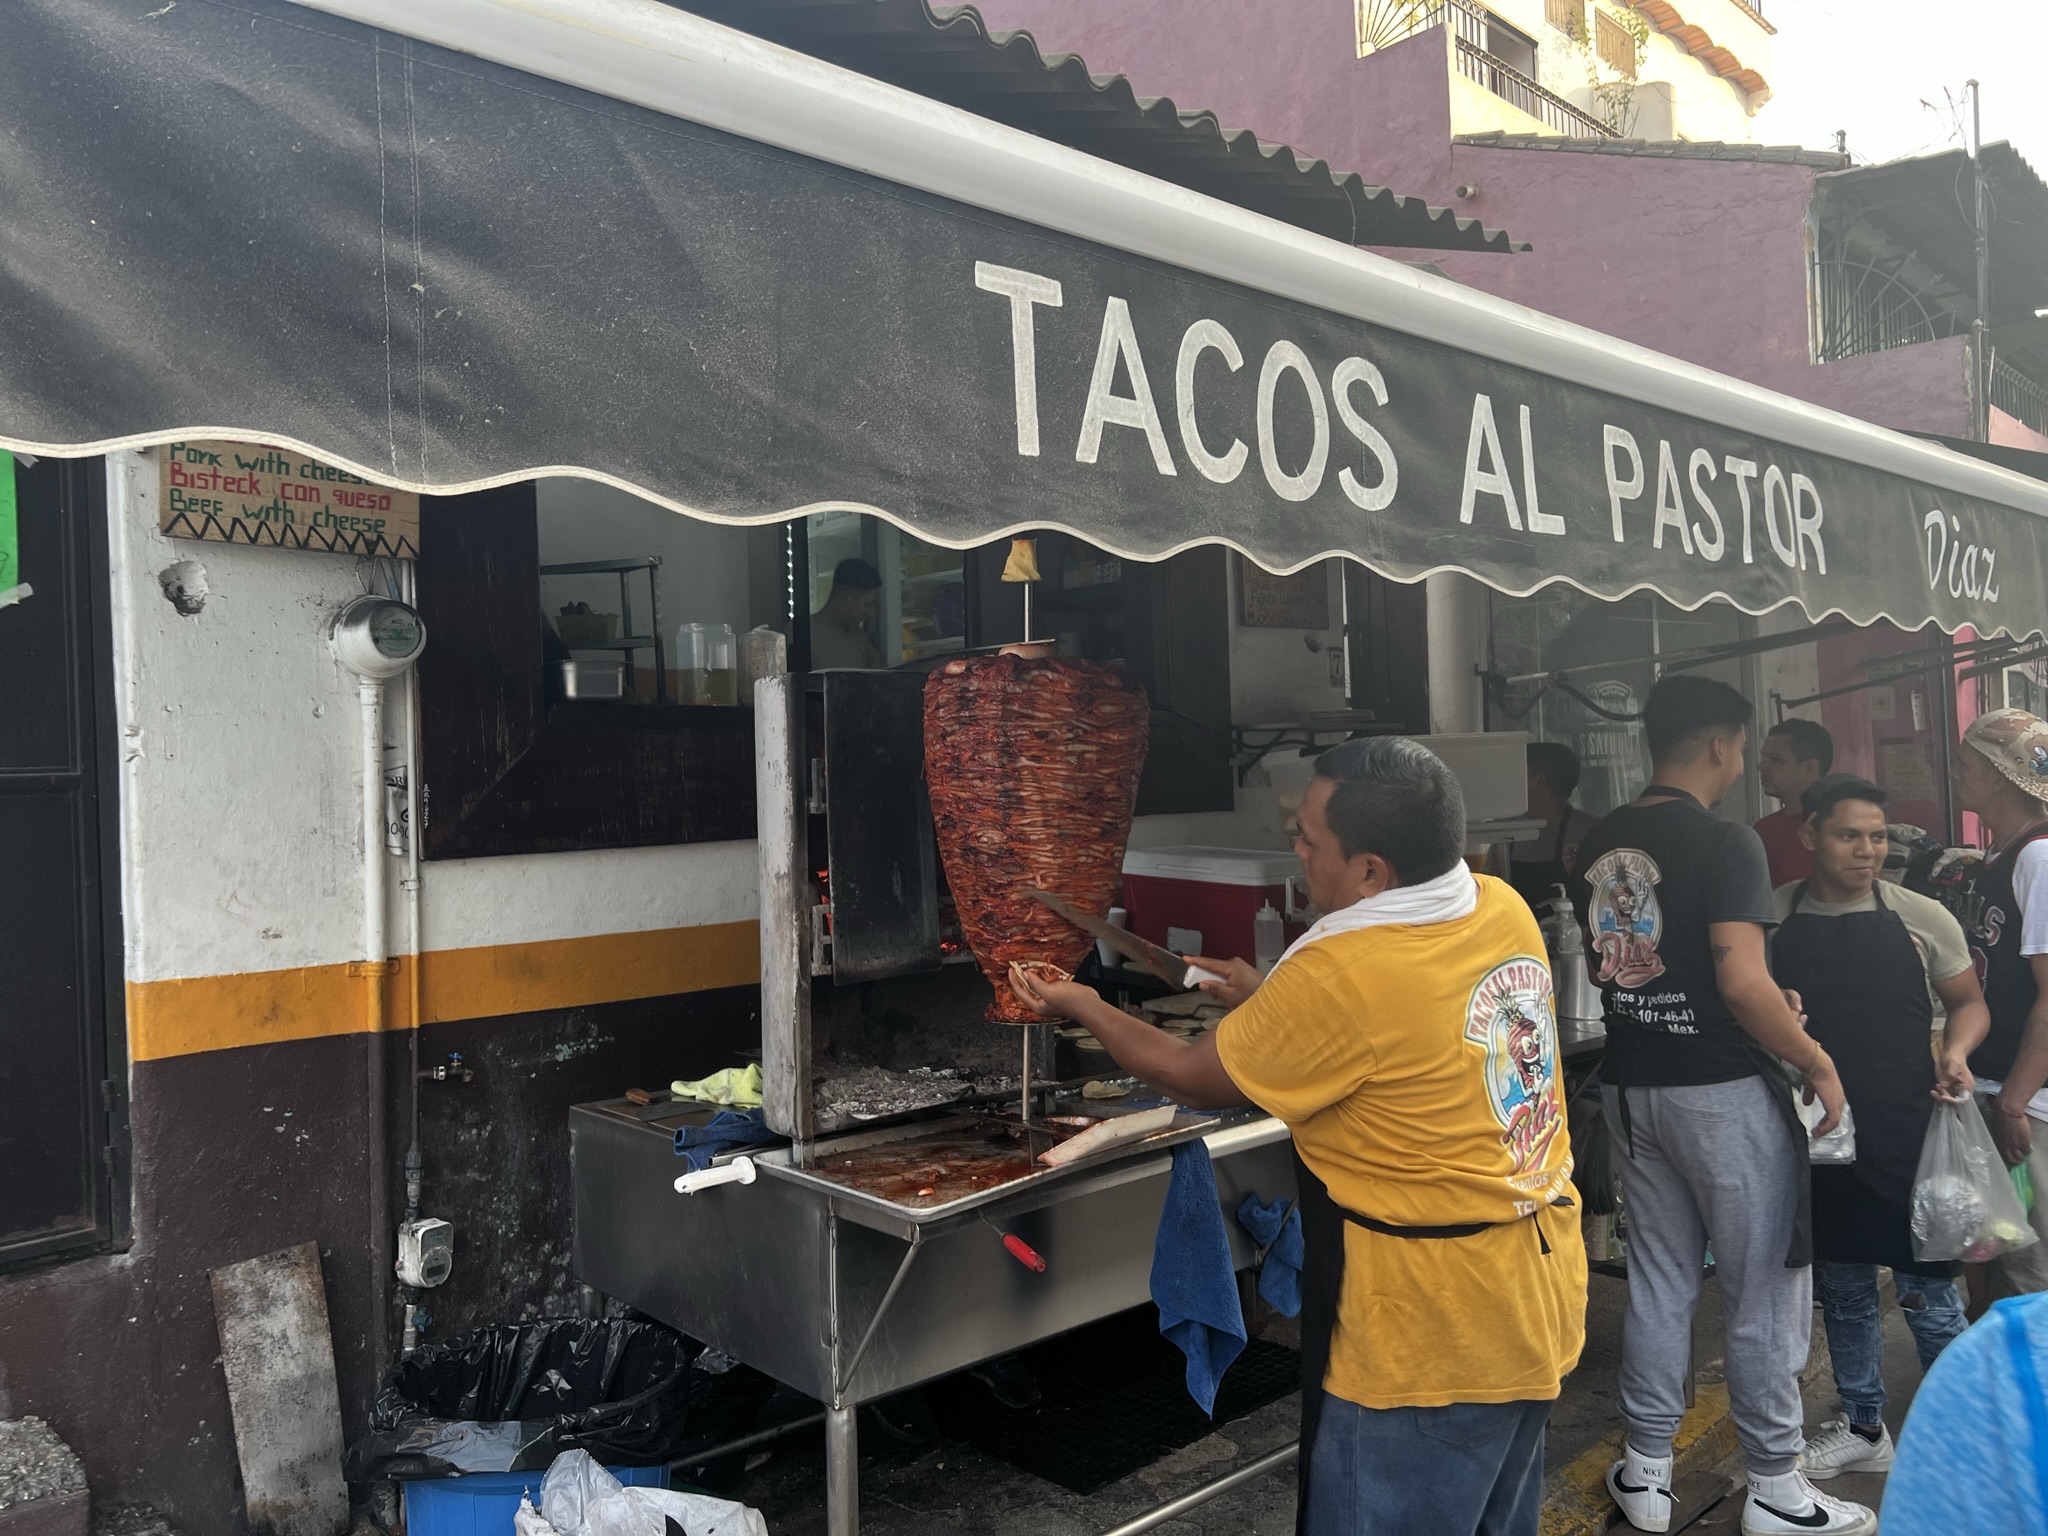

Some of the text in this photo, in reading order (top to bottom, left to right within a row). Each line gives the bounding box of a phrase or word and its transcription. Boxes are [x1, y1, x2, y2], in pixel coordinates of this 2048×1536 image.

[975, 260, 2000, 602] TACOS AL PASTOR Diaz
[170, 441, 223, 467] Pork
[235, 452, 290, 476] with
[170, 461, 391, 511] Bisteck con queso
[170, 488, 386, 534] Beef with cheese
[1470, 981, 1498, 1038] TACOS
[1507, 965, 1551, 999] PASTOR
[1668, 1023, 1699, 1035] Mex.
[1642, 1466, 1662, 1477] NIKE
